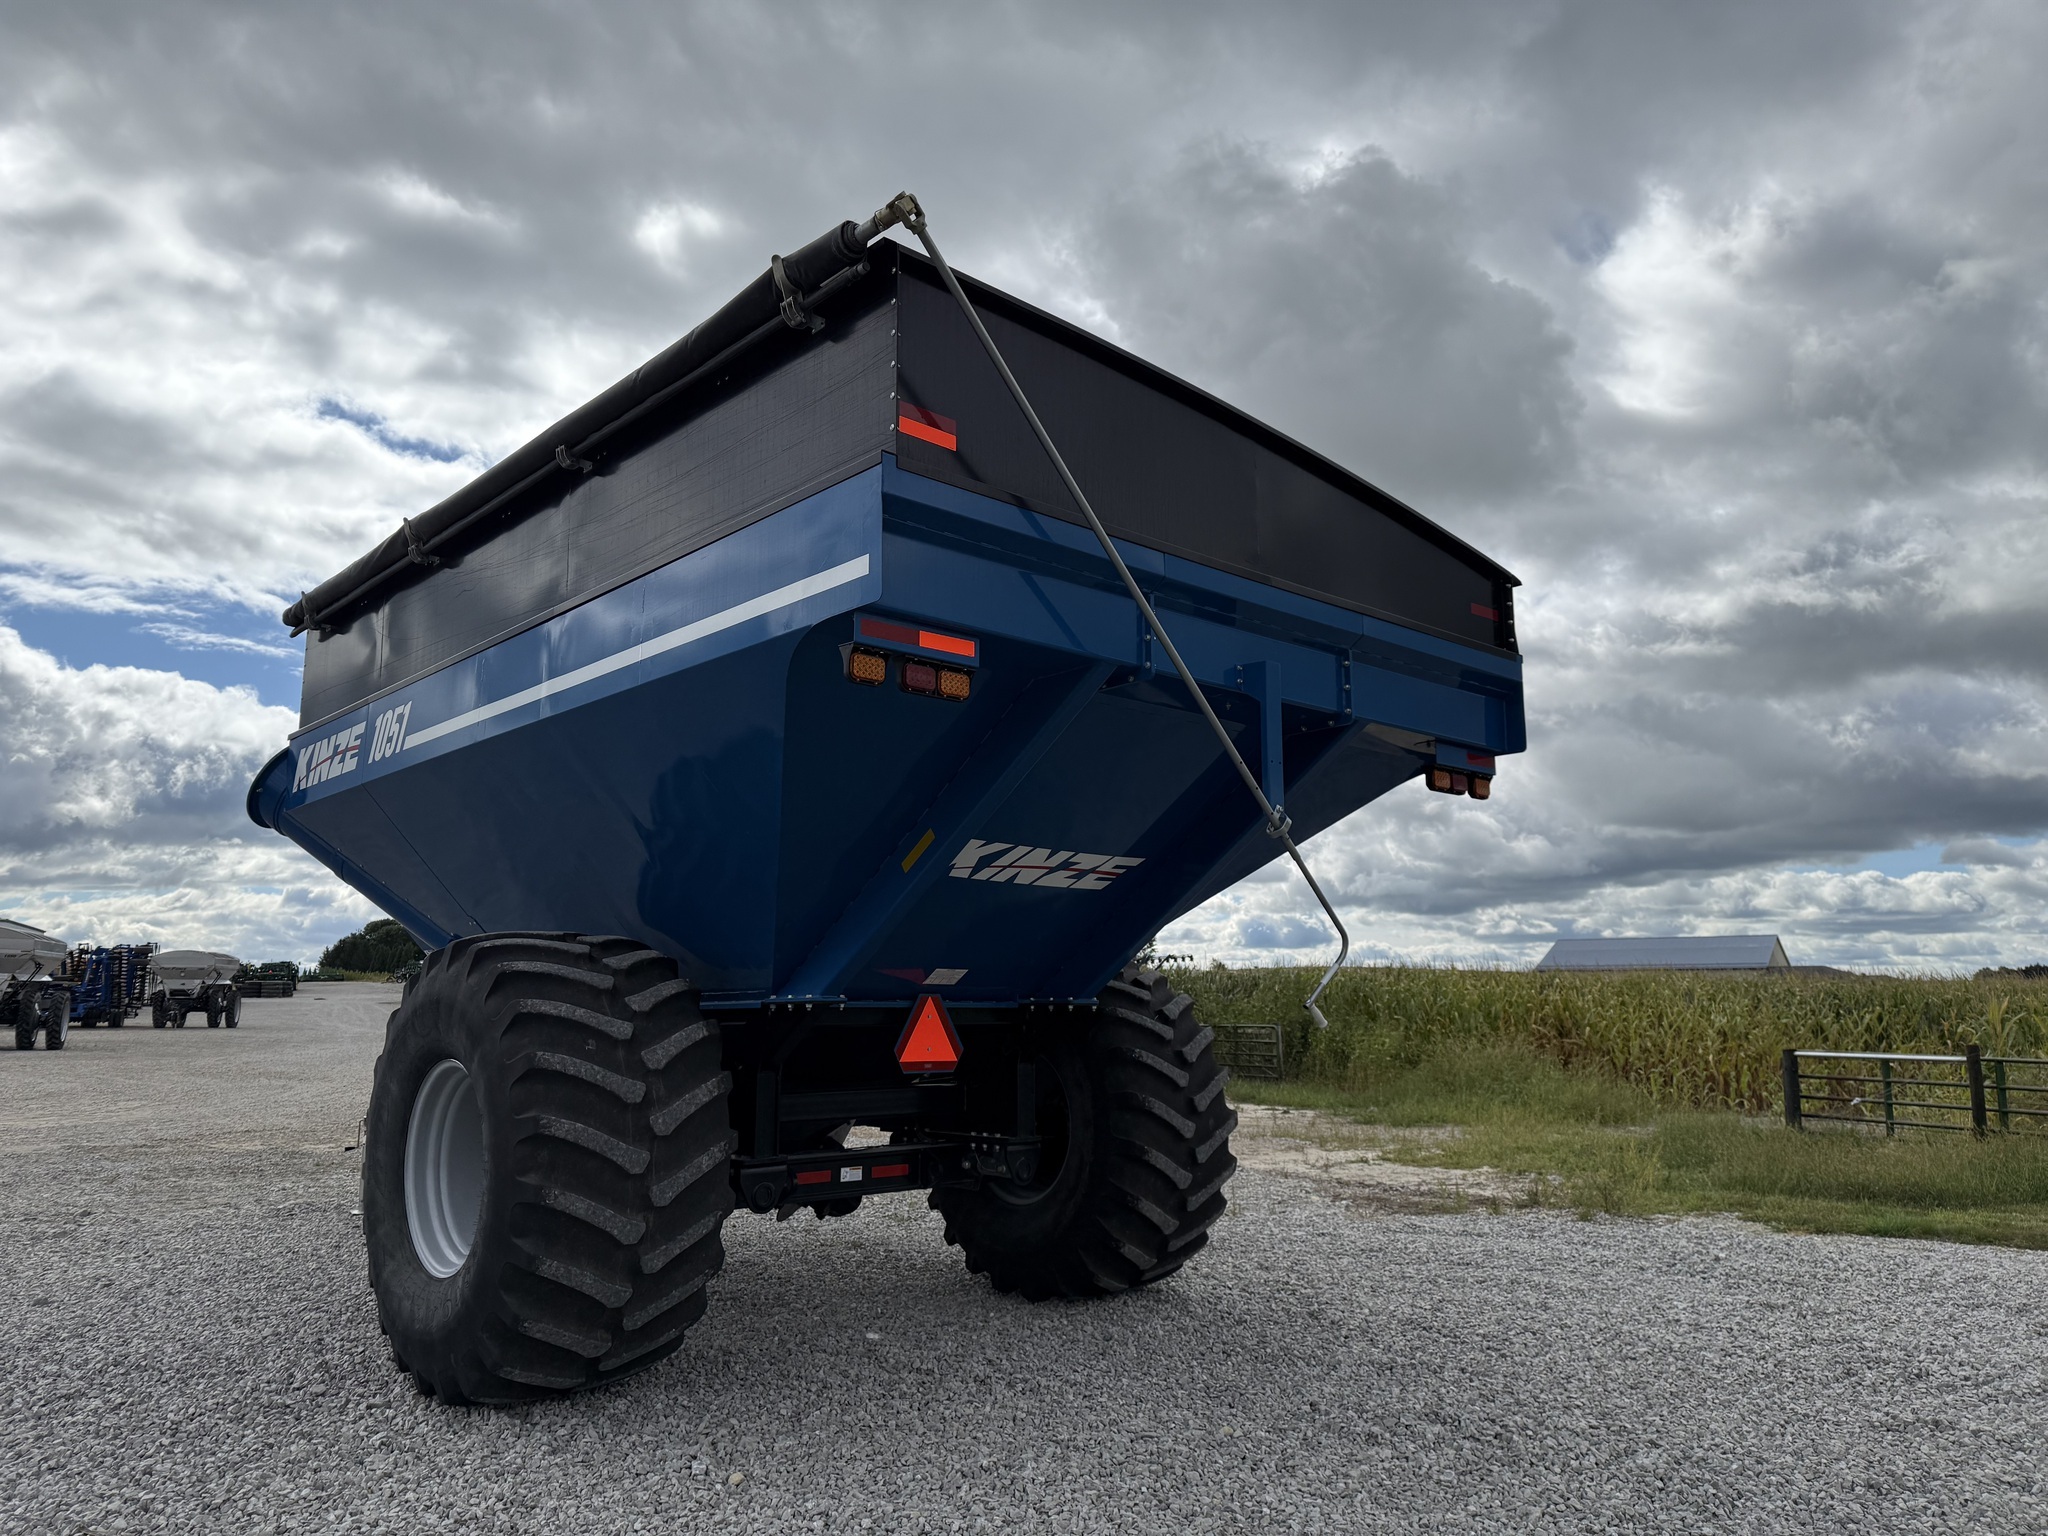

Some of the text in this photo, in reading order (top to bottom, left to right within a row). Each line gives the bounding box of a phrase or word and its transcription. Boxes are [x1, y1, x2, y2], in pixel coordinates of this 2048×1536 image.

[292, 700, 412, 793] KINZE 1051
[949, 839, 1146, 890] KINZE
